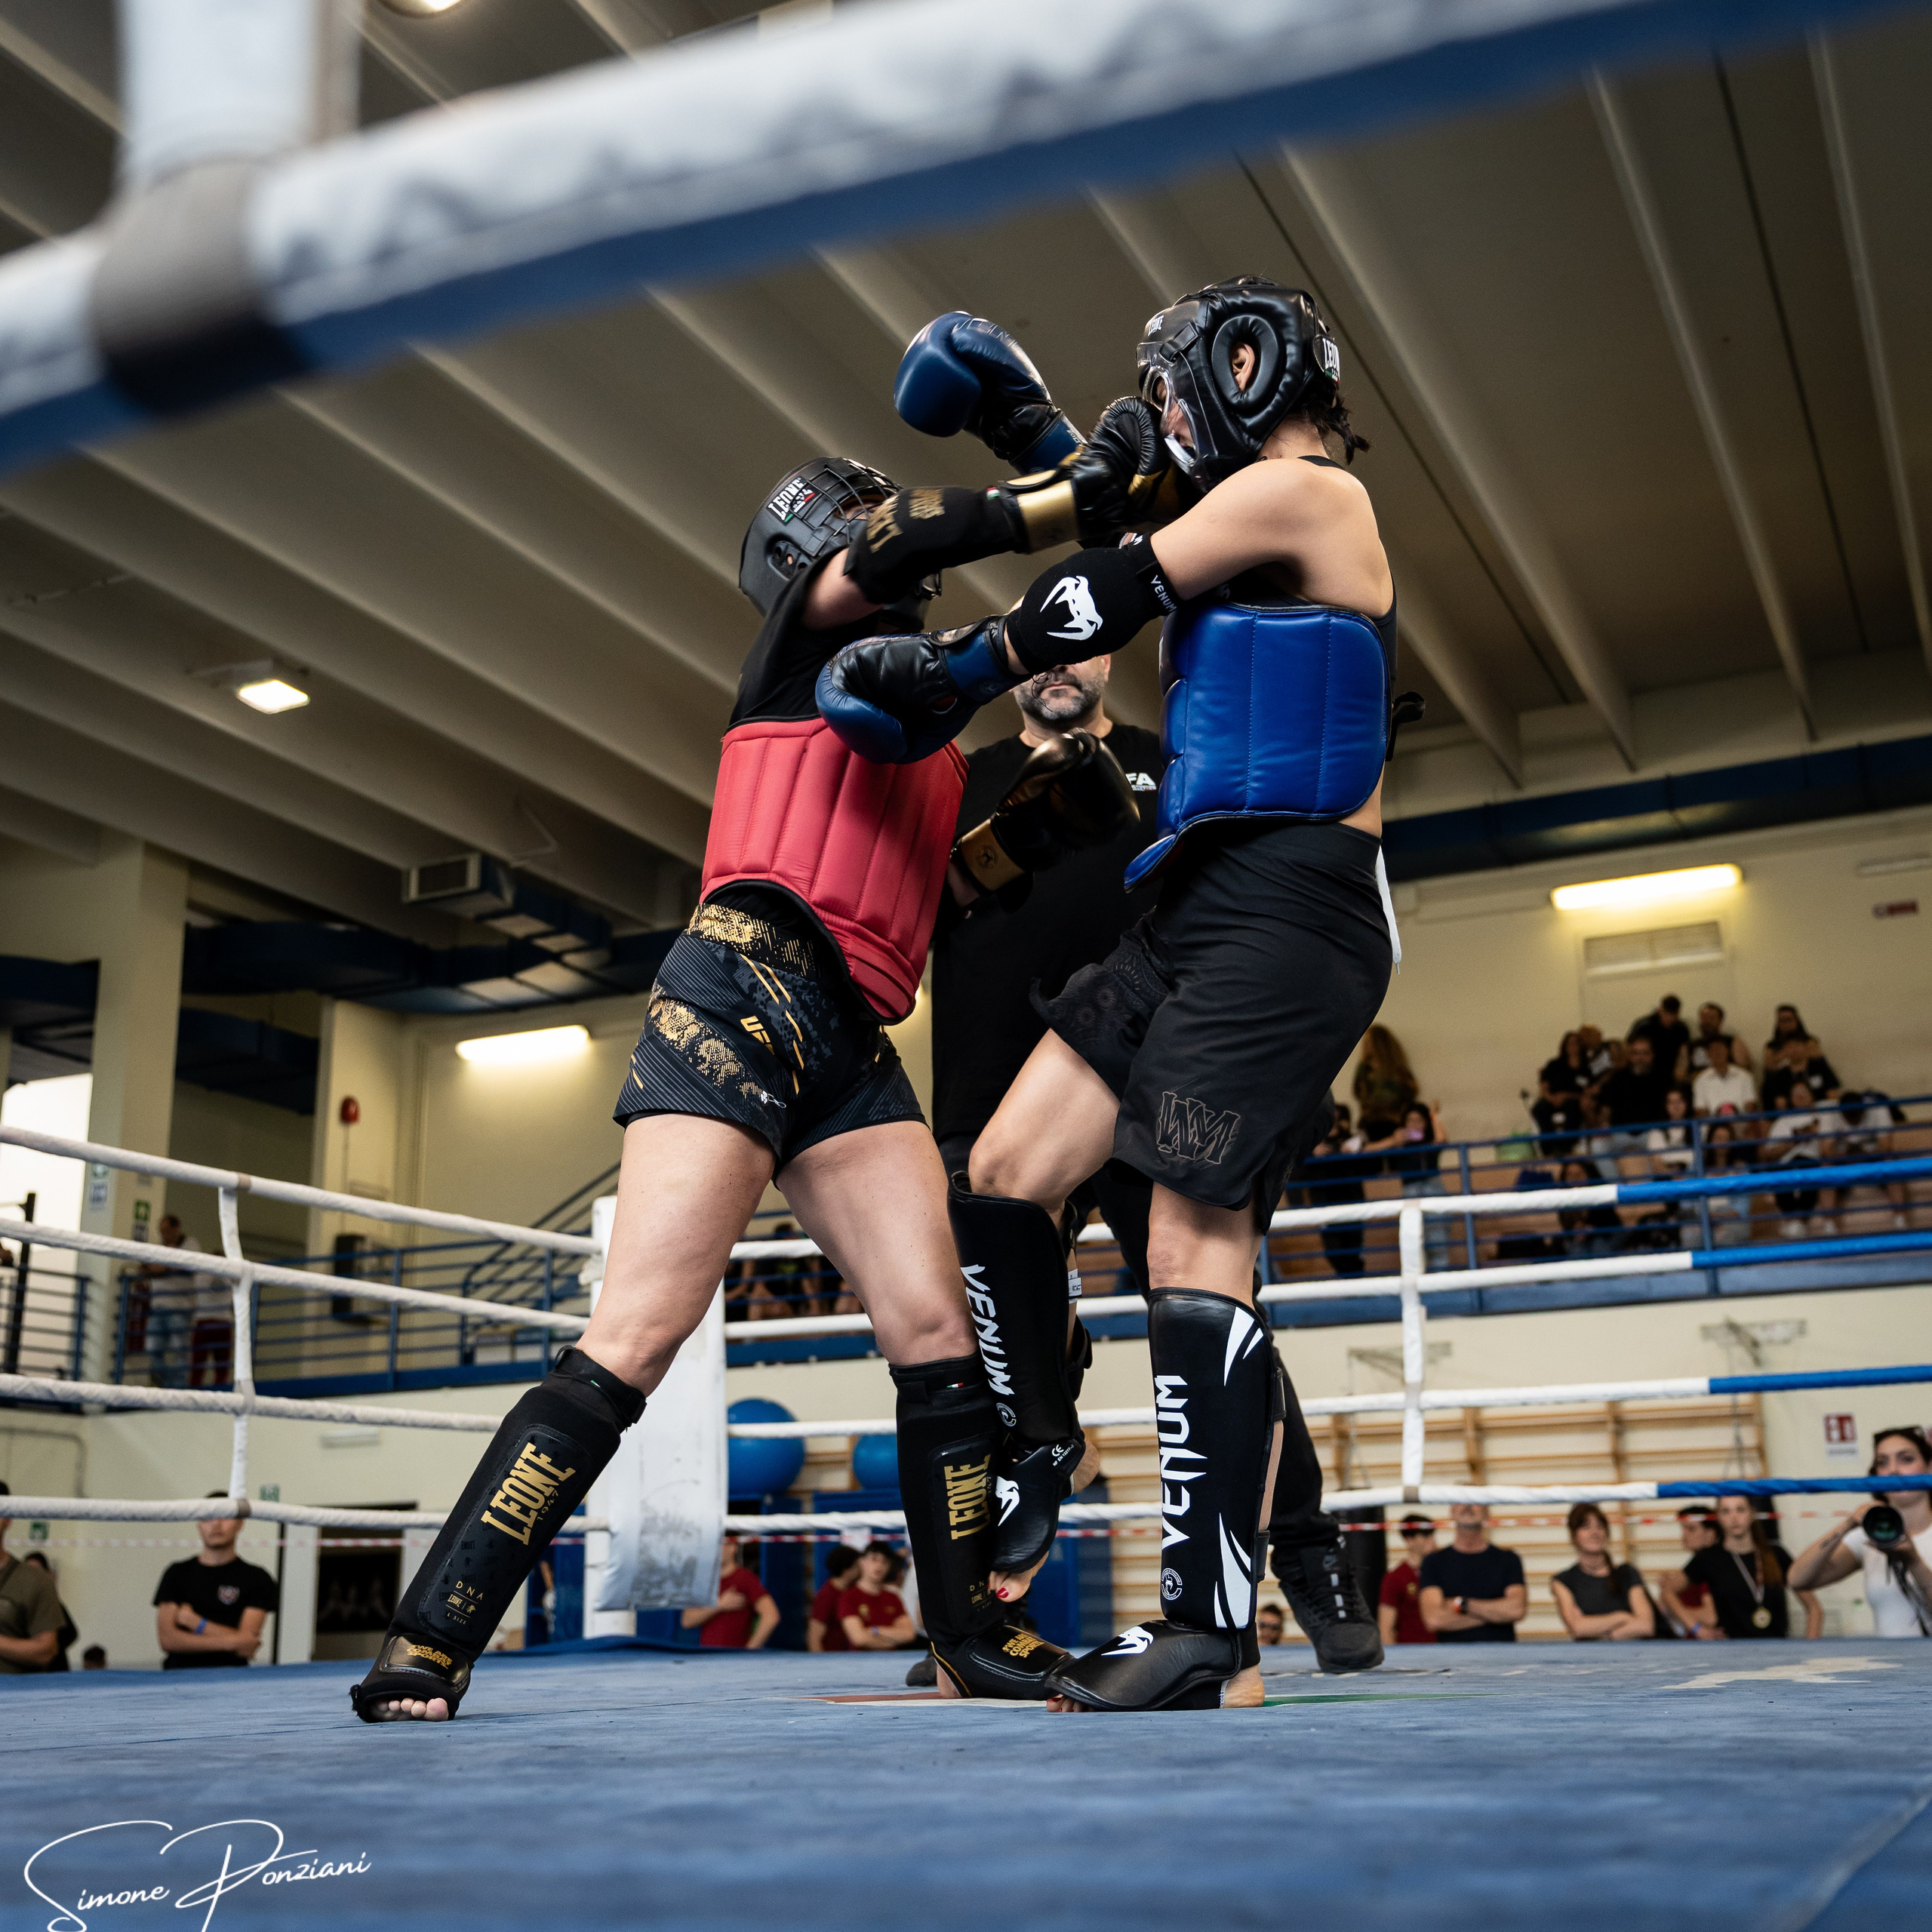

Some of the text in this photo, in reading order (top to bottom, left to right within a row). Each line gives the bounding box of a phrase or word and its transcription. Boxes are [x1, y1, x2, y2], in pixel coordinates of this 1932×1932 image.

[768, 477, 814, 521] LEONE
[1151, 575, 1177, 613] VENUM
[1125, 772, 1156, 786] FA
[960, 1264, 1015, 1395] VENUM
[1051, 1444, 1064, 1457] CE
[1154, 1374, 1208, 1552] VENUM
[481, 1441, 577, 1546] LEONE
[537, 1490, 559, 1521] 1947
[943, 1454, 992, 1540] LEONE
[456, 1580, 484, 1601] DNA
